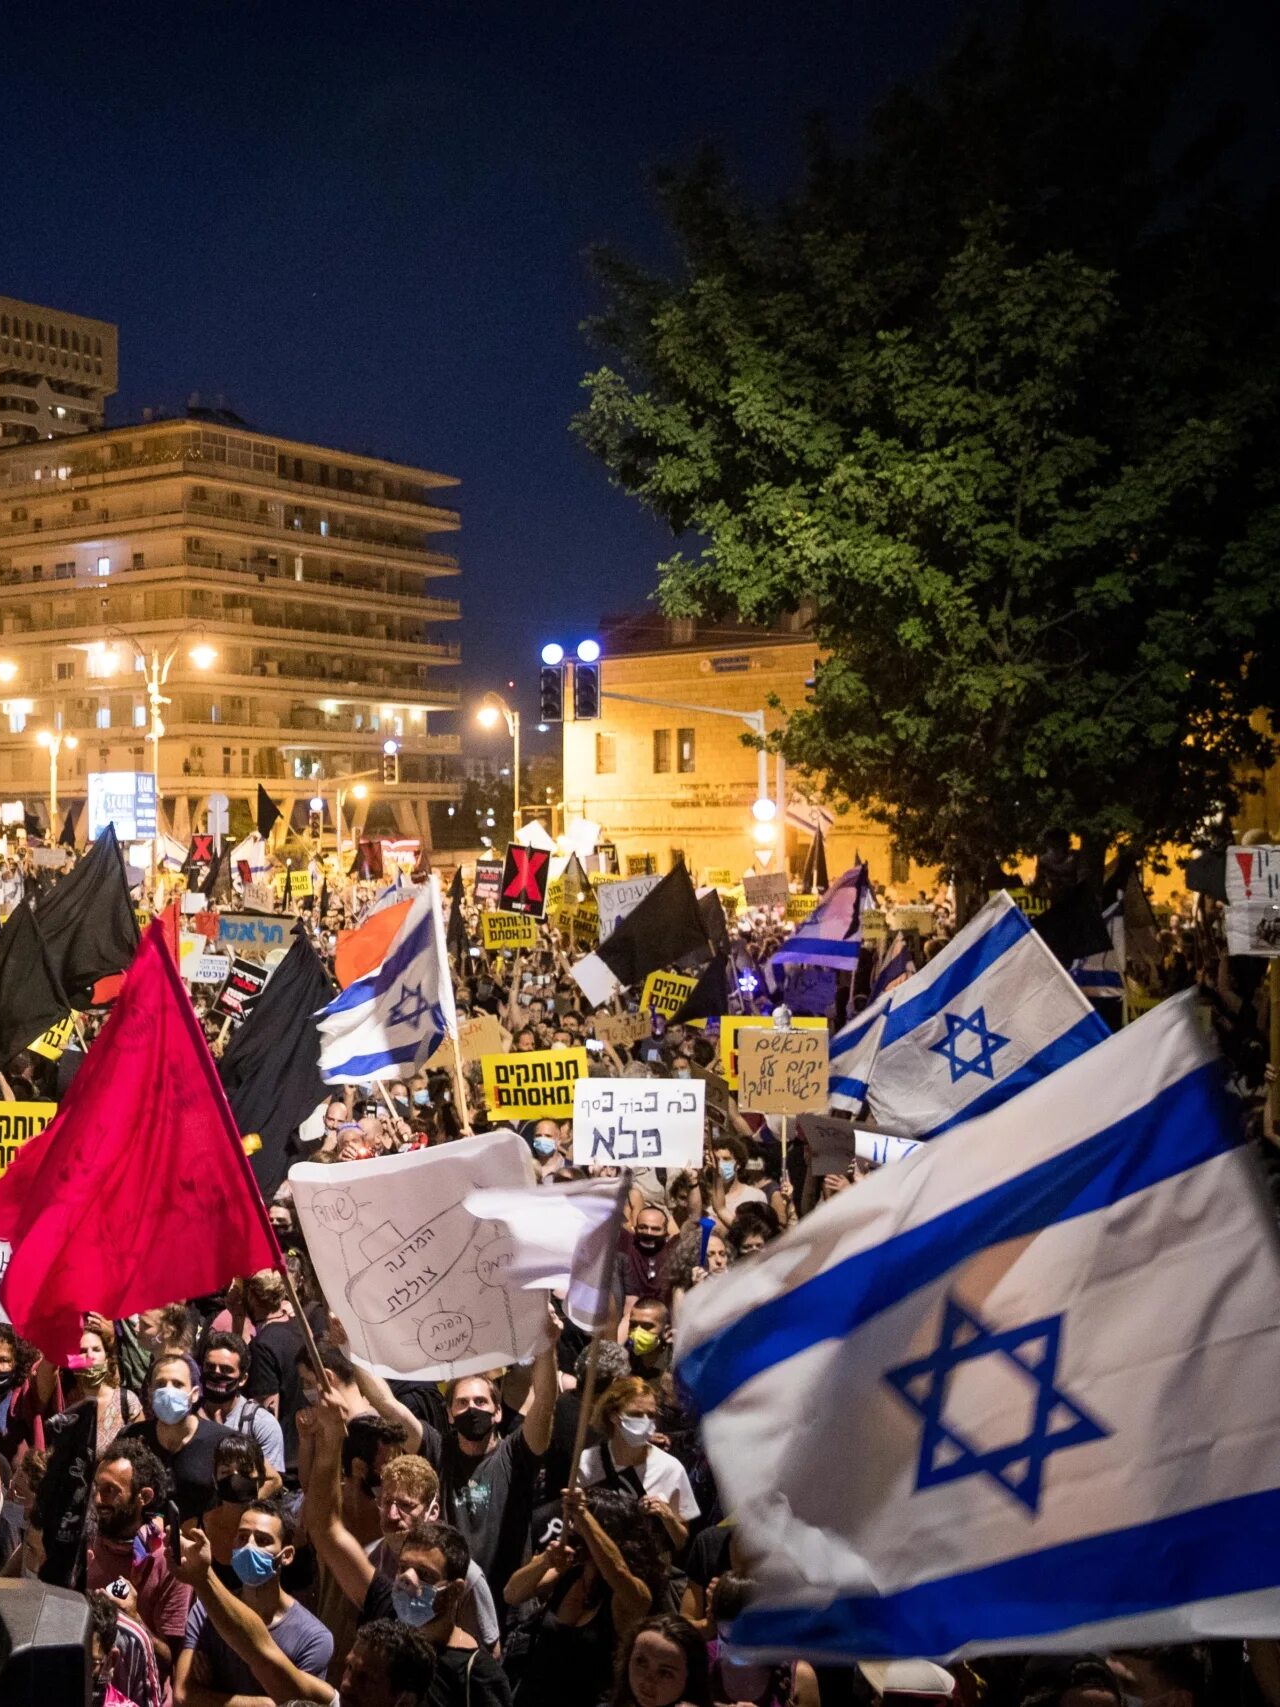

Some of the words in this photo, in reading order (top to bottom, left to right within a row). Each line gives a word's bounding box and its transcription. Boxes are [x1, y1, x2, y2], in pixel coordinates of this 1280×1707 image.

[653, 978, 691, 998] ותקים
[755, 1034, 819, 1053] הנאשם
[495, 1059, 579, 1086] מנותקים
[761, 1054, 778, 1077] על
[786, 1060, 823, 1080] יקום
[494, 1086, 576, 1109] מאסתם!
[591, 1116, 662, 1160] כלא
[384, 1227, 436, 1274] המדינה
[388, 1265, 439, 1312] צוללת
[431, 1316, 462, 1338] הפרת
